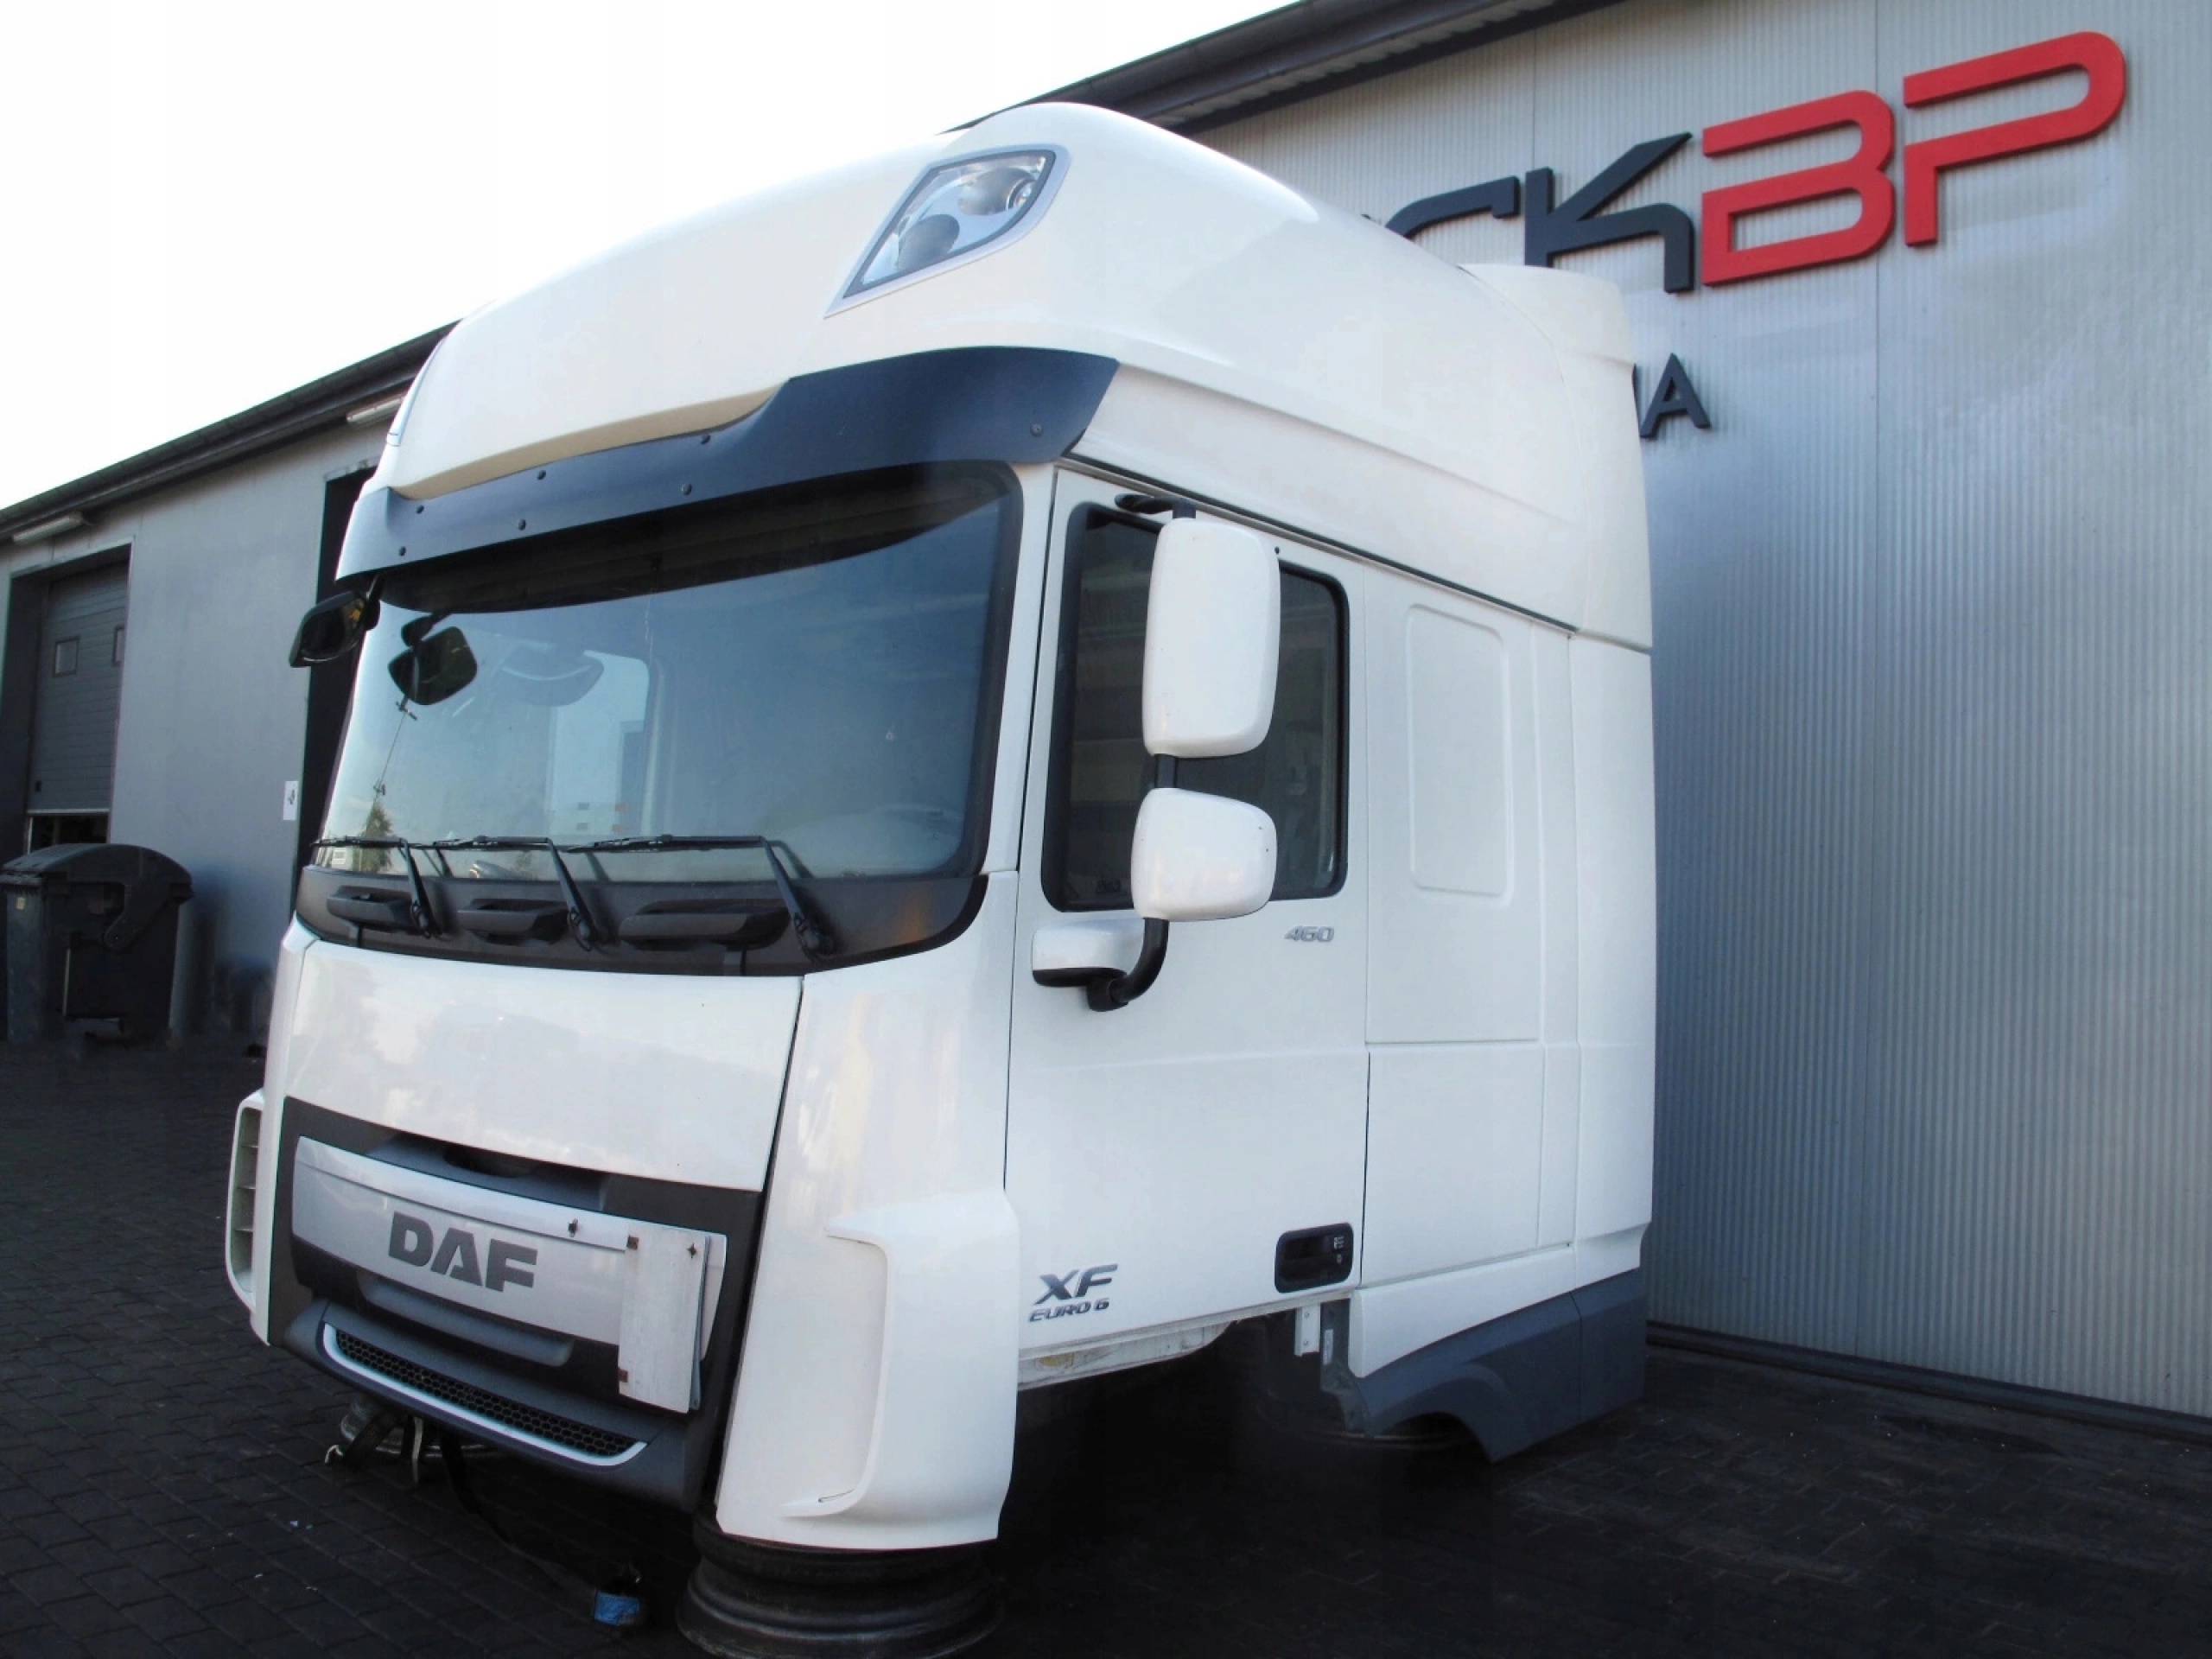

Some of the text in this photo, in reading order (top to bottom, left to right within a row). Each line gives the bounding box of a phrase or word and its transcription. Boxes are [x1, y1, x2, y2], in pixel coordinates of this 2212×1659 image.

[1632, 352, 1711, 439] A
[1284, 925, 1335, 942] 460
[387, 1211, 538, 1293] DAF
[1033, 1263, 1118, 1305] XF
[1029, 1297, 1109, 1322] EURO 6
